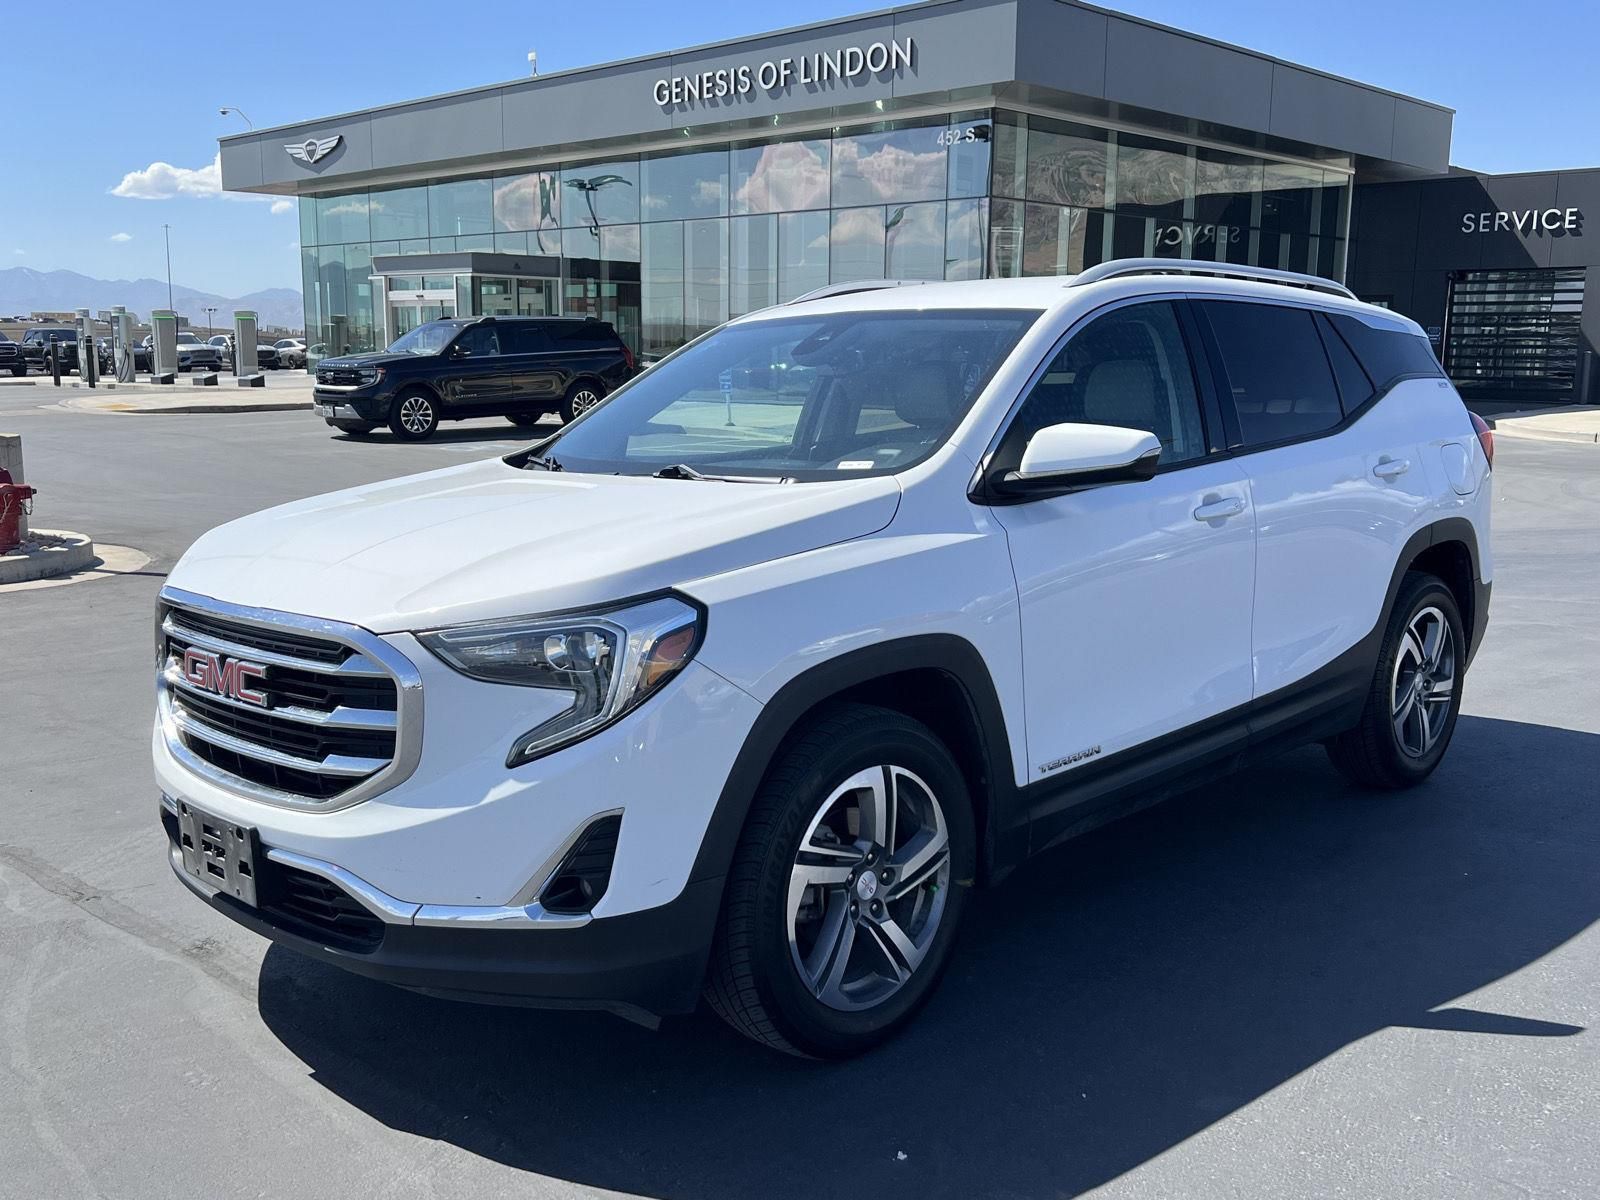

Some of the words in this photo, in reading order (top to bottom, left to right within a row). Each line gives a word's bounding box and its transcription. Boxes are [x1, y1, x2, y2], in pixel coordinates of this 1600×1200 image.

[653, 65, 750, 107] GENESIS
[758, 58, 792, 90] OF
[800, 37, 913, 84] LINDON
[937, 129, 961, 146] 452
[965, 127, 978, 143] S.
[1461, 208, 1578, 233] SERVICE
[184, 645, 269, 708] GMC
